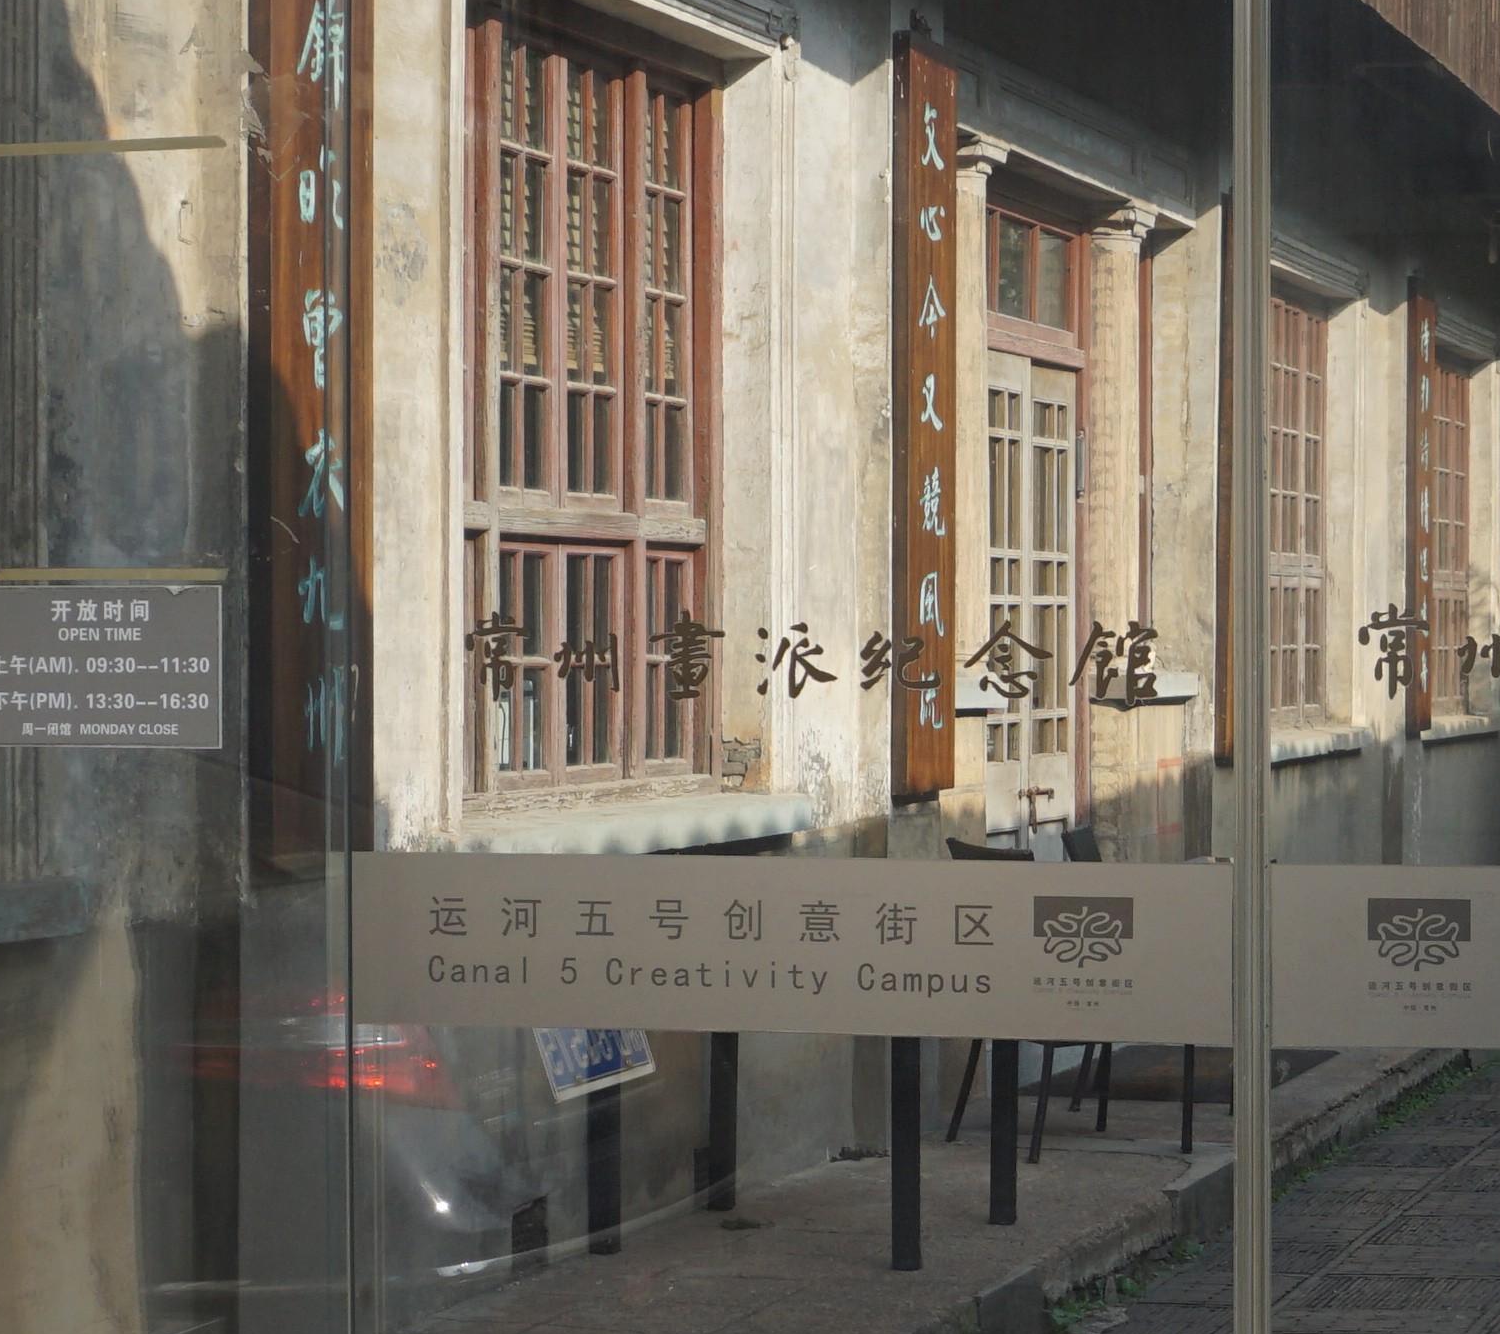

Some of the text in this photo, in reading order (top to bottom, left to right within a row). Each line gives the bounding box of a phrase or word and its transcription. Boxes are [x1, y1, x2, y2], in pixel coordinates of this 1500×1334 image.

[51, 599, 150, 622] 开放时间
[58, 627, 142, 641] OPEN TIME
[21, 722, 179, 737] 周一闭馆 MONDAY CLOSE
[427, 896, 996, 948] 运河五号创意街区
[427, 955, 994, 999] Canal 5 Creativity Campus
